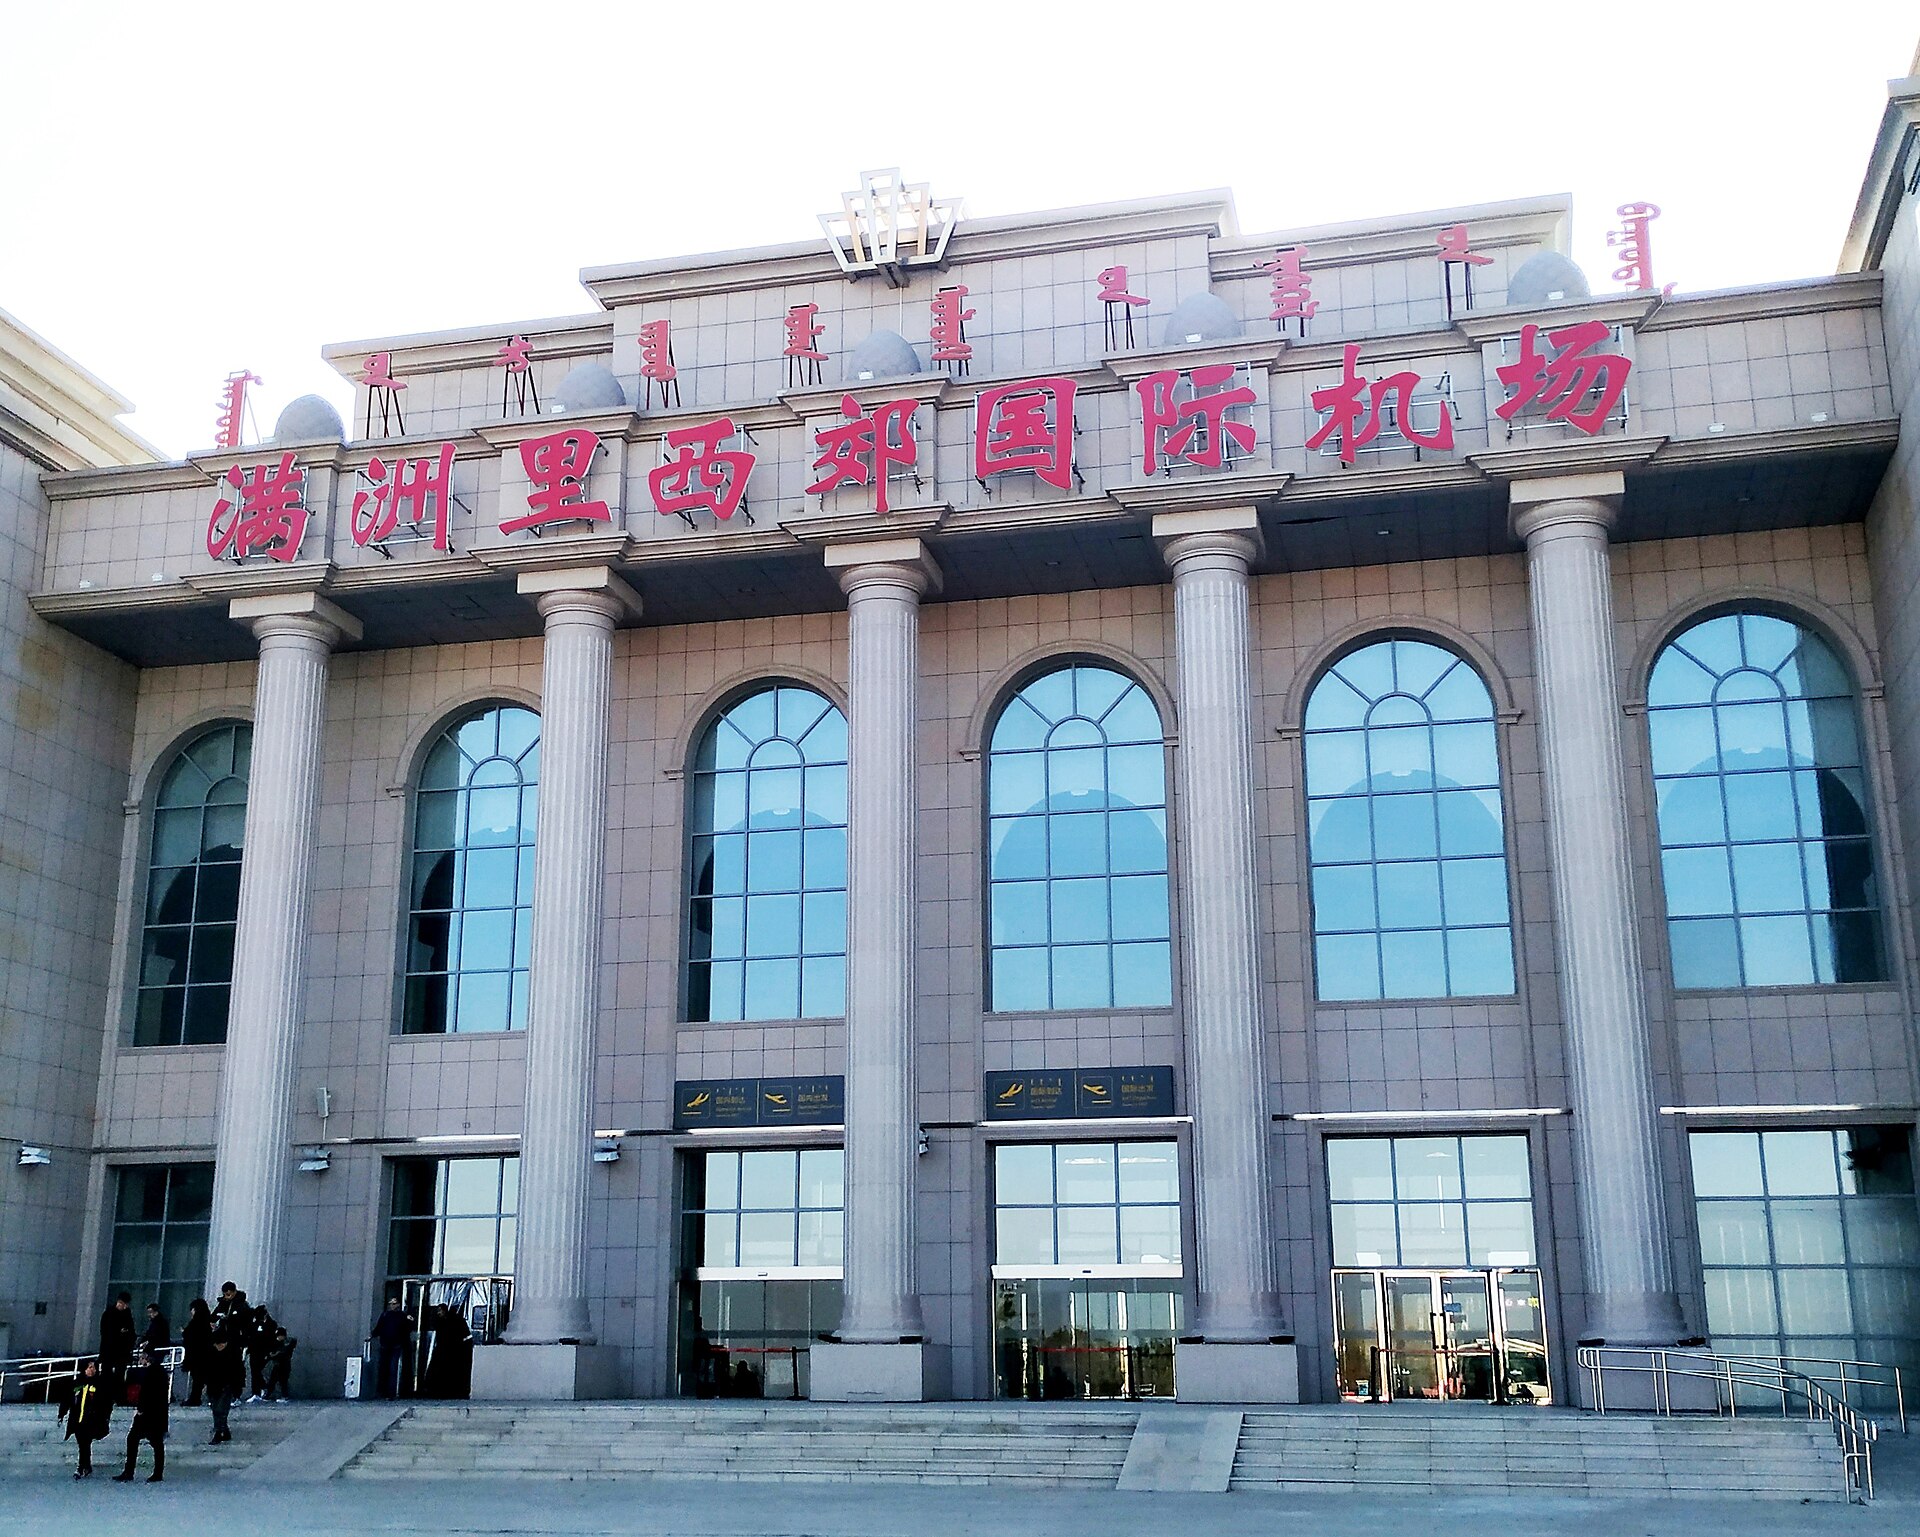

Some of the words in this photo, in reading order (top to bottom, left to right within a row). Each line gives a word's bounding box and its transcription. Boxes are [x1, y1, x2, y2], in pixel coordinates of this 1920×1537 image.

[206, 319, 1634, 566] 满洲里西郊国际机场
